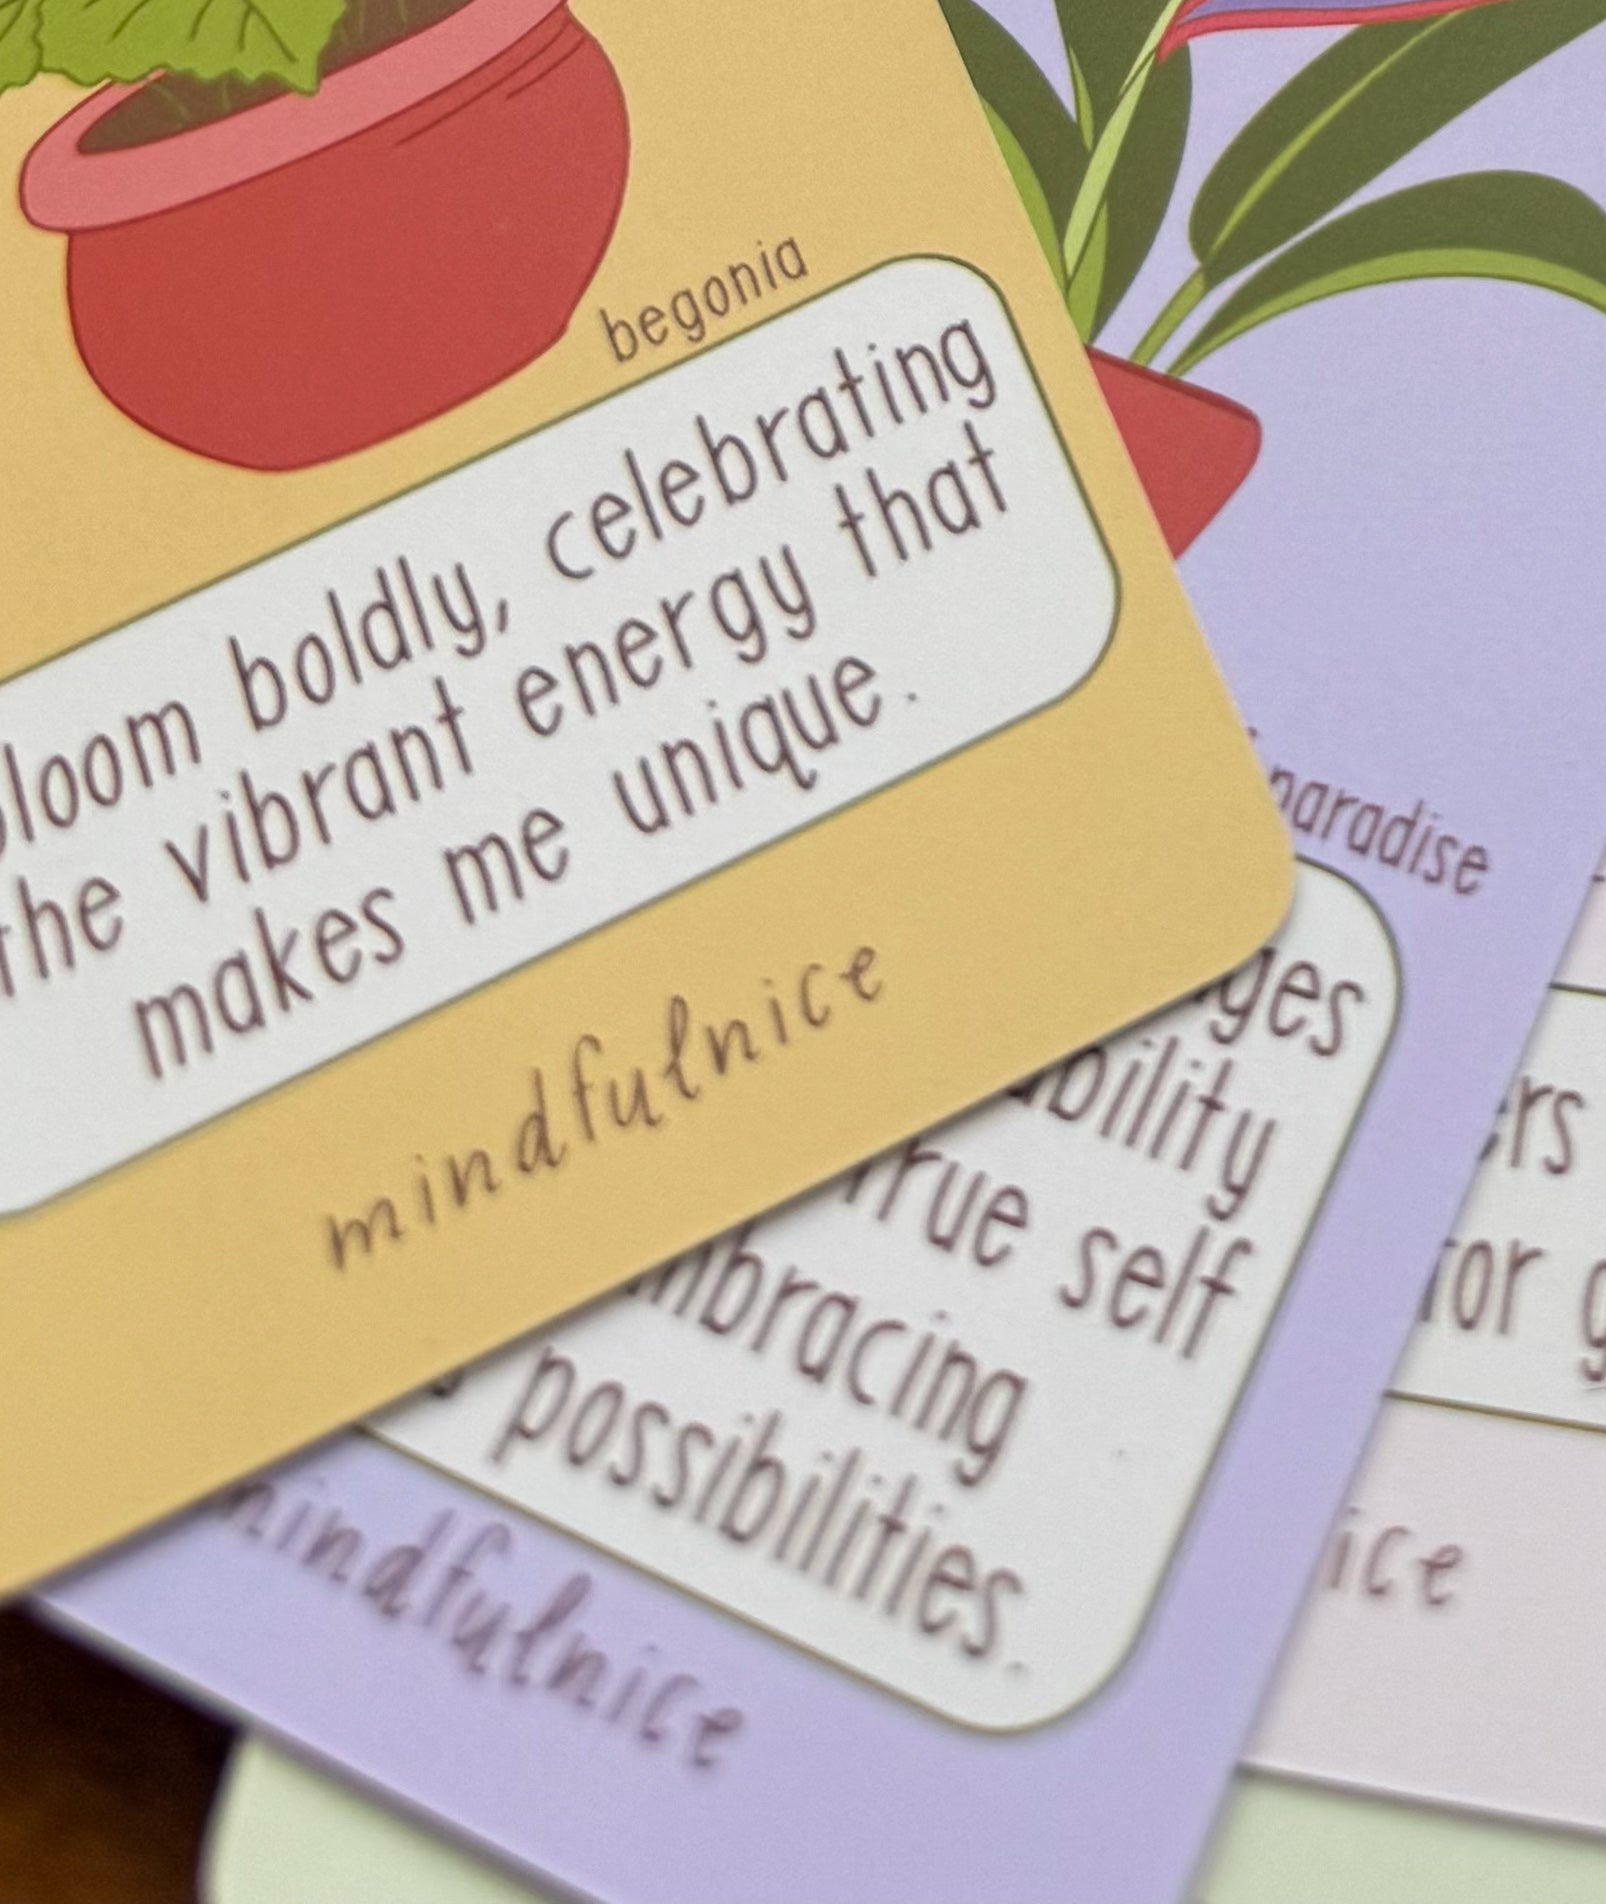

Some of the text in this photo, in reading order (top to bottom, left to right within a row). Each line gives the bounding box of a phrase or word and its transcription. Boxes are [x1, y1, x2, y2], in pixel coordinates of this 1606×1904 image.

[600, 235, 811, 365] begonia
[164, 677, 475, 906] vibrant
[515, 542, 818, 739] energy
[835, 421, 1011, 579] that
[228, 554, 512, 733] boldly,
[545, 315, 1000, 583] celebrating
[132, 652, 921, 1082] makes me unique.
[323, 942, 885, 1275] mindfulnice
[1058, 1225, 1253, 1359] self
[492, 1346, 1034, 1678] possibilities.
